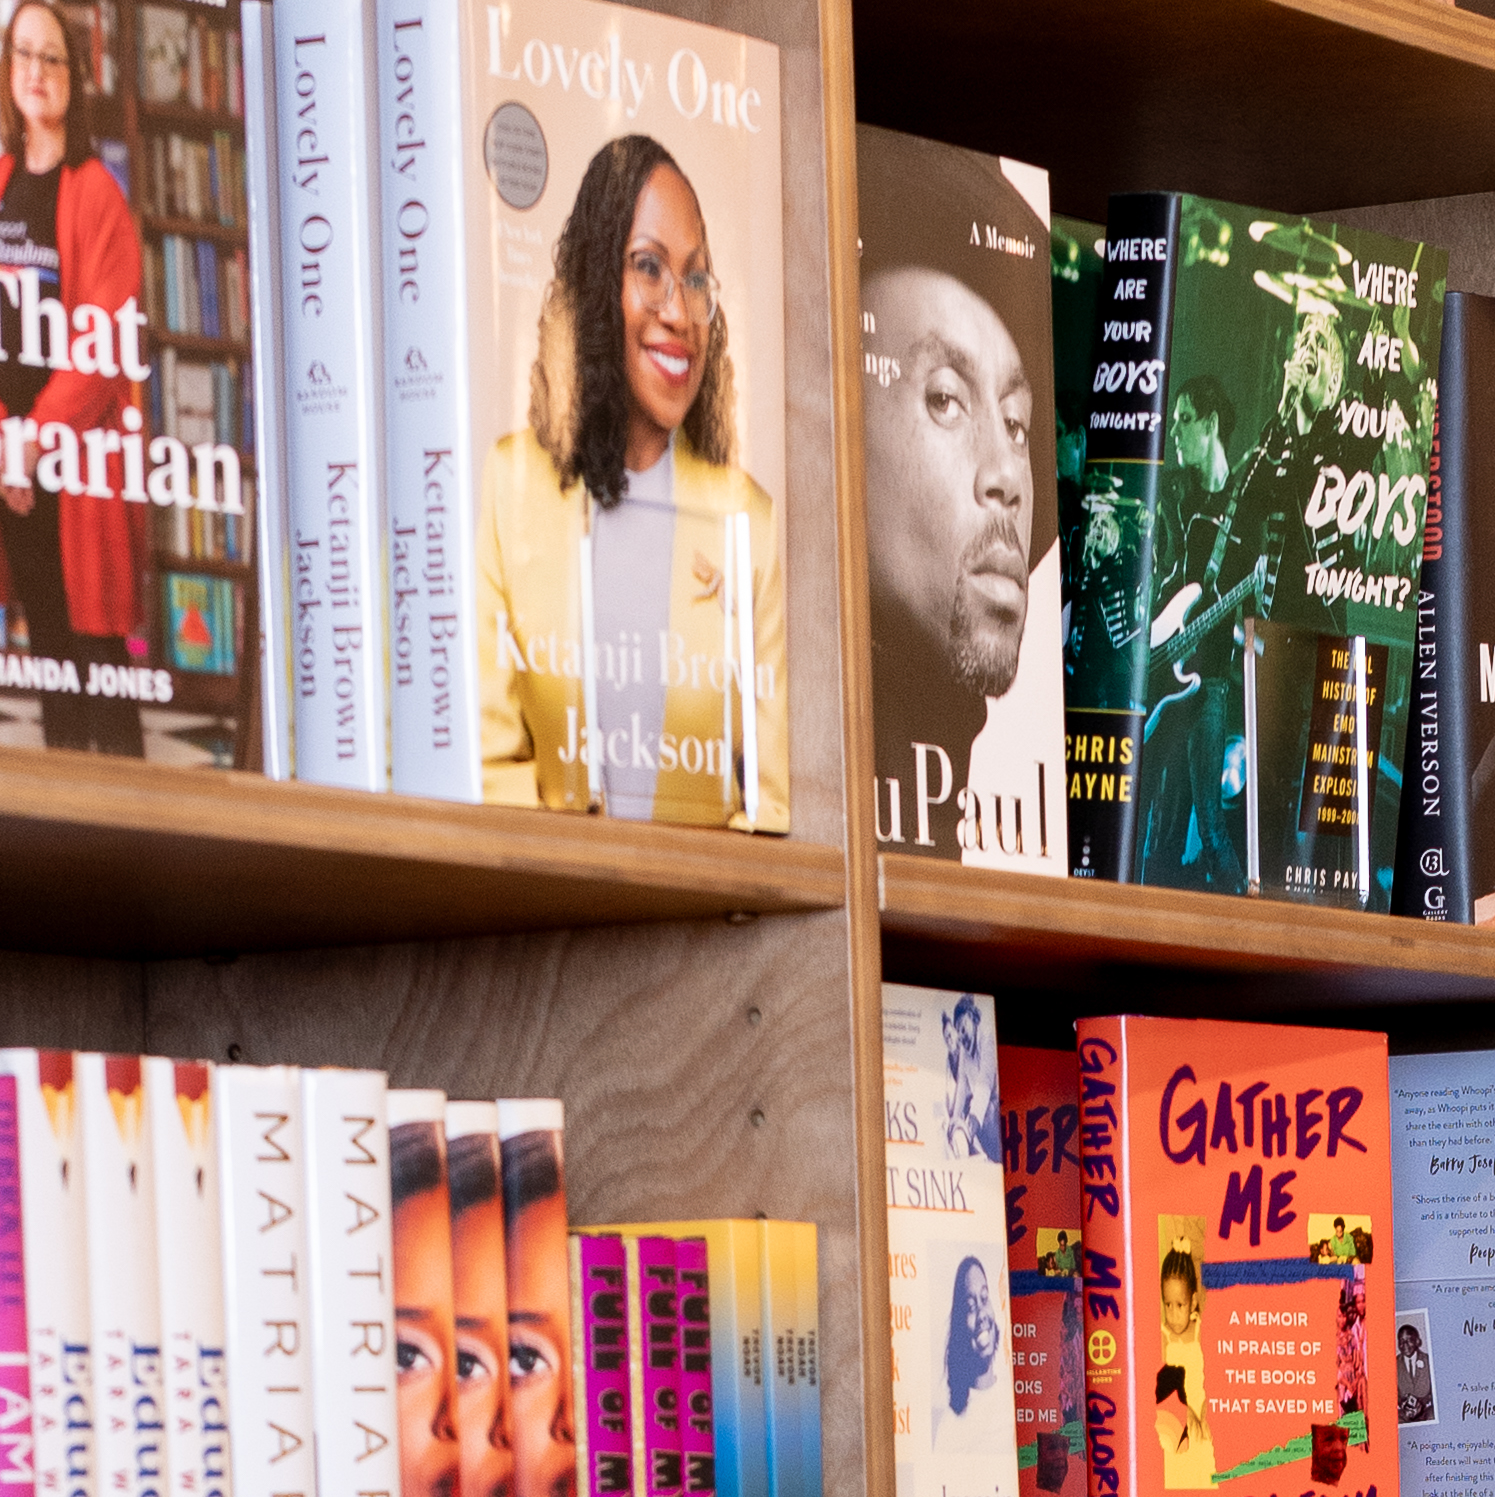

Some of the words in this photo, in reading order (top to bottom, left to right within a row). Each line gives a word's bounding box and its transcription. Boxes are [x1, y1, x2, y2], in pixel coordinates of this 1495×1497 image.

[1158, 1064, 1369, 1168] GATHER
[1216, 1165, 1299, 1249] ME
[1228, 1313, 1240, 1326] A
[1243, 1310, 1309, 1327] MEMOIR
[1217, 1340, 1233, 1355] IN
[1236, 1339, 1295, 1357] PRAISE
[1299, 1339, 1322, 1356] OF
[1224, 1369, 1256, 1385] THE
[1259, 1368, 1317, 1386] BOOKS
[1209, 1398, 1246, 1415] THAT
[1249, 1398, 1304, 1415] SAVED
[1307, 1398, 1335, 1415] ME
